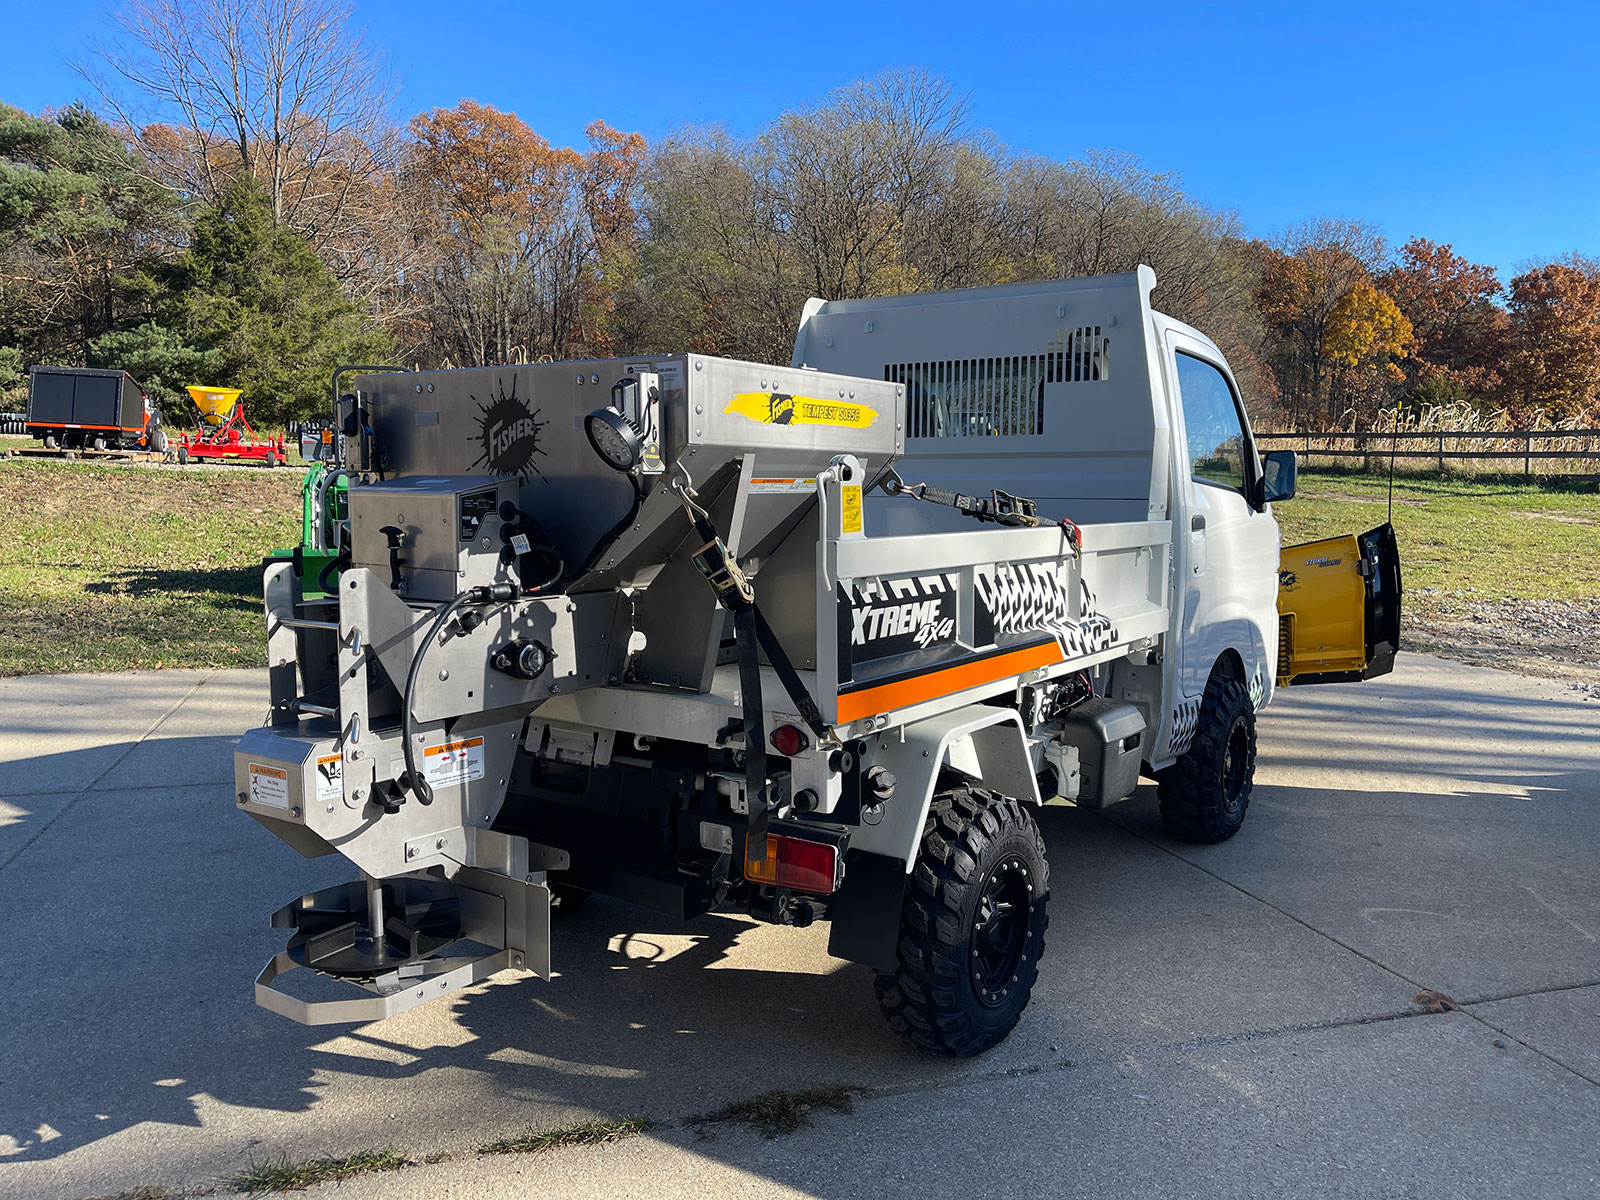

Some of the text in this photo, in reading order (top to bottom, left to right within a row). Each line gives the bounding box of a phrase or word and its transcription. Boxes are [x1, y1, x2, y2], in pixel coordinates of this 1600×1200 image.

[772, 398, 793, 420] FISHER
[803, 403, 838, 420] TEMPEST
[490, 418, 535, 462] FISHER
[1304, 557, 1328, 566] STORM
[851, 598, 942, 646] XTREME
